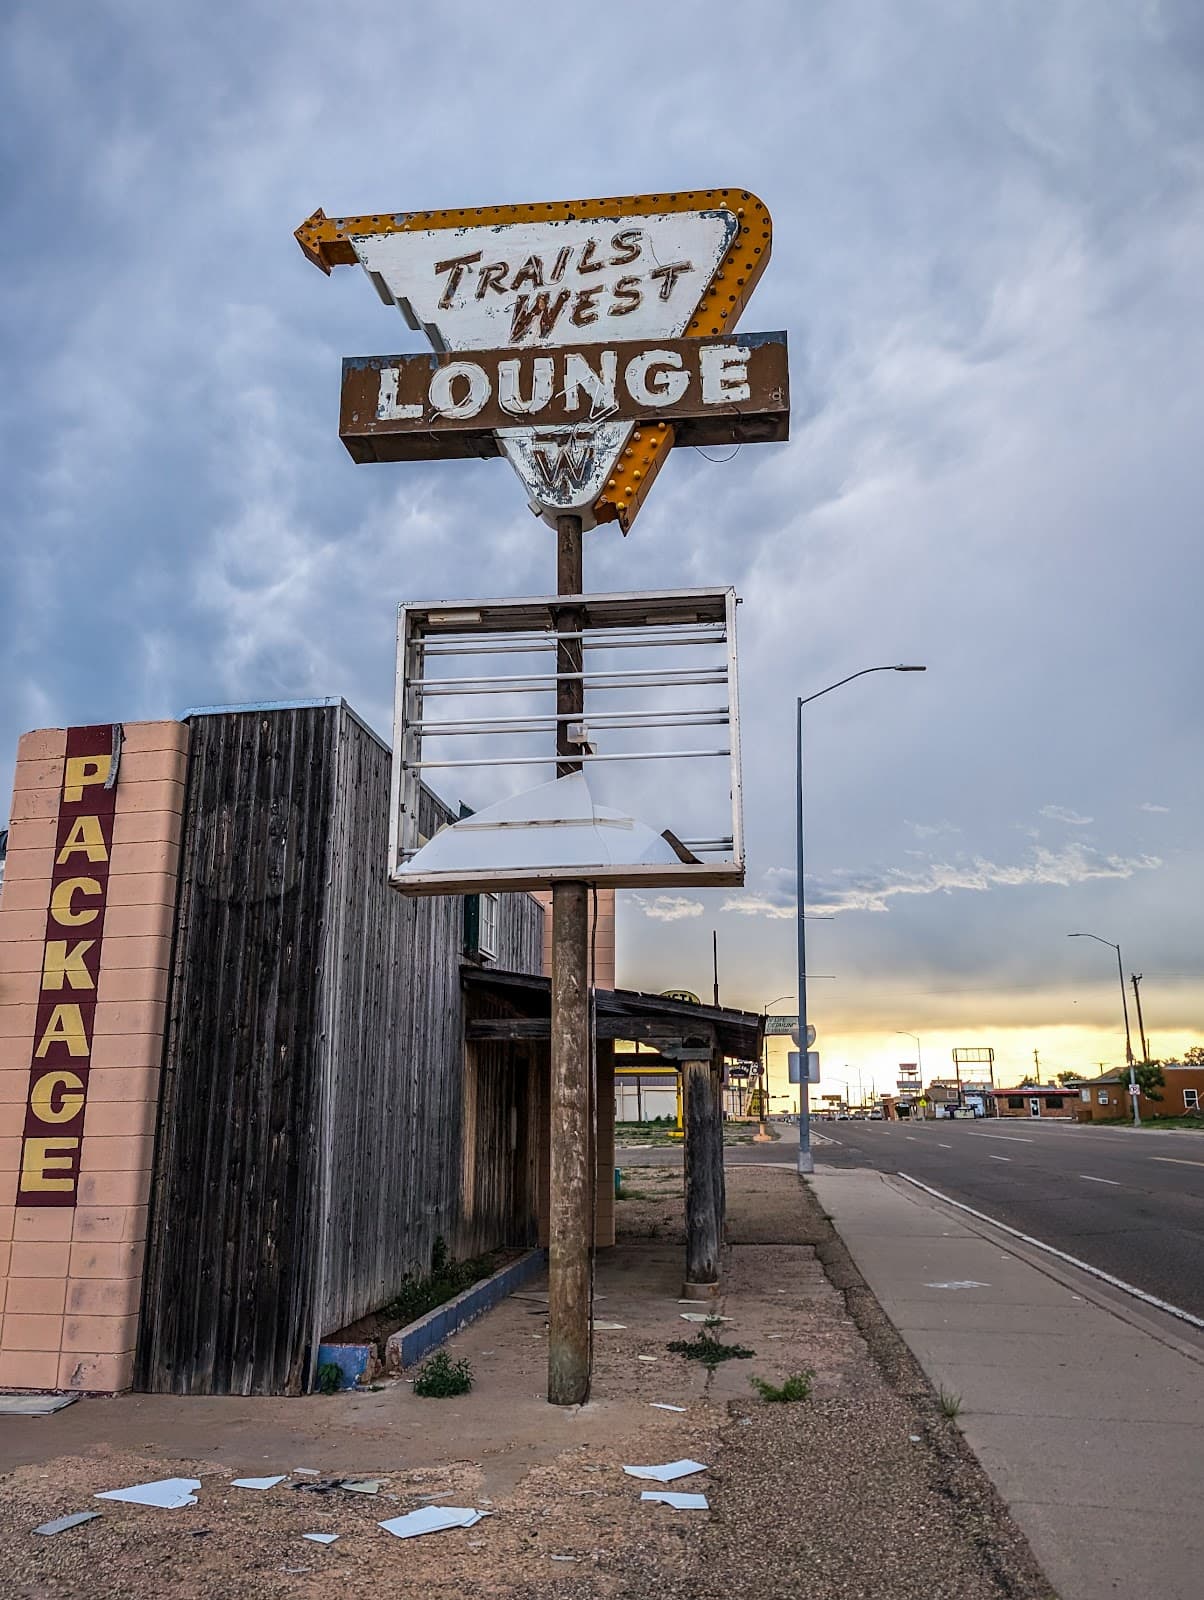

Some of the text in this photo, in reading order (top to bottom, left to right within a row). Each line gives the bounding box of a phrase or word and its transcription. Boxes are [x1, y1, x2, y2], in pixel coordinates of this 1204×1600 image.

[434, 228, 643, 310] TRAILS
[508, 260, 694, 343] WEST
[376, 345, 751, 421] LOUNGE
[20, 754, 113, 1192] PACKAGE
